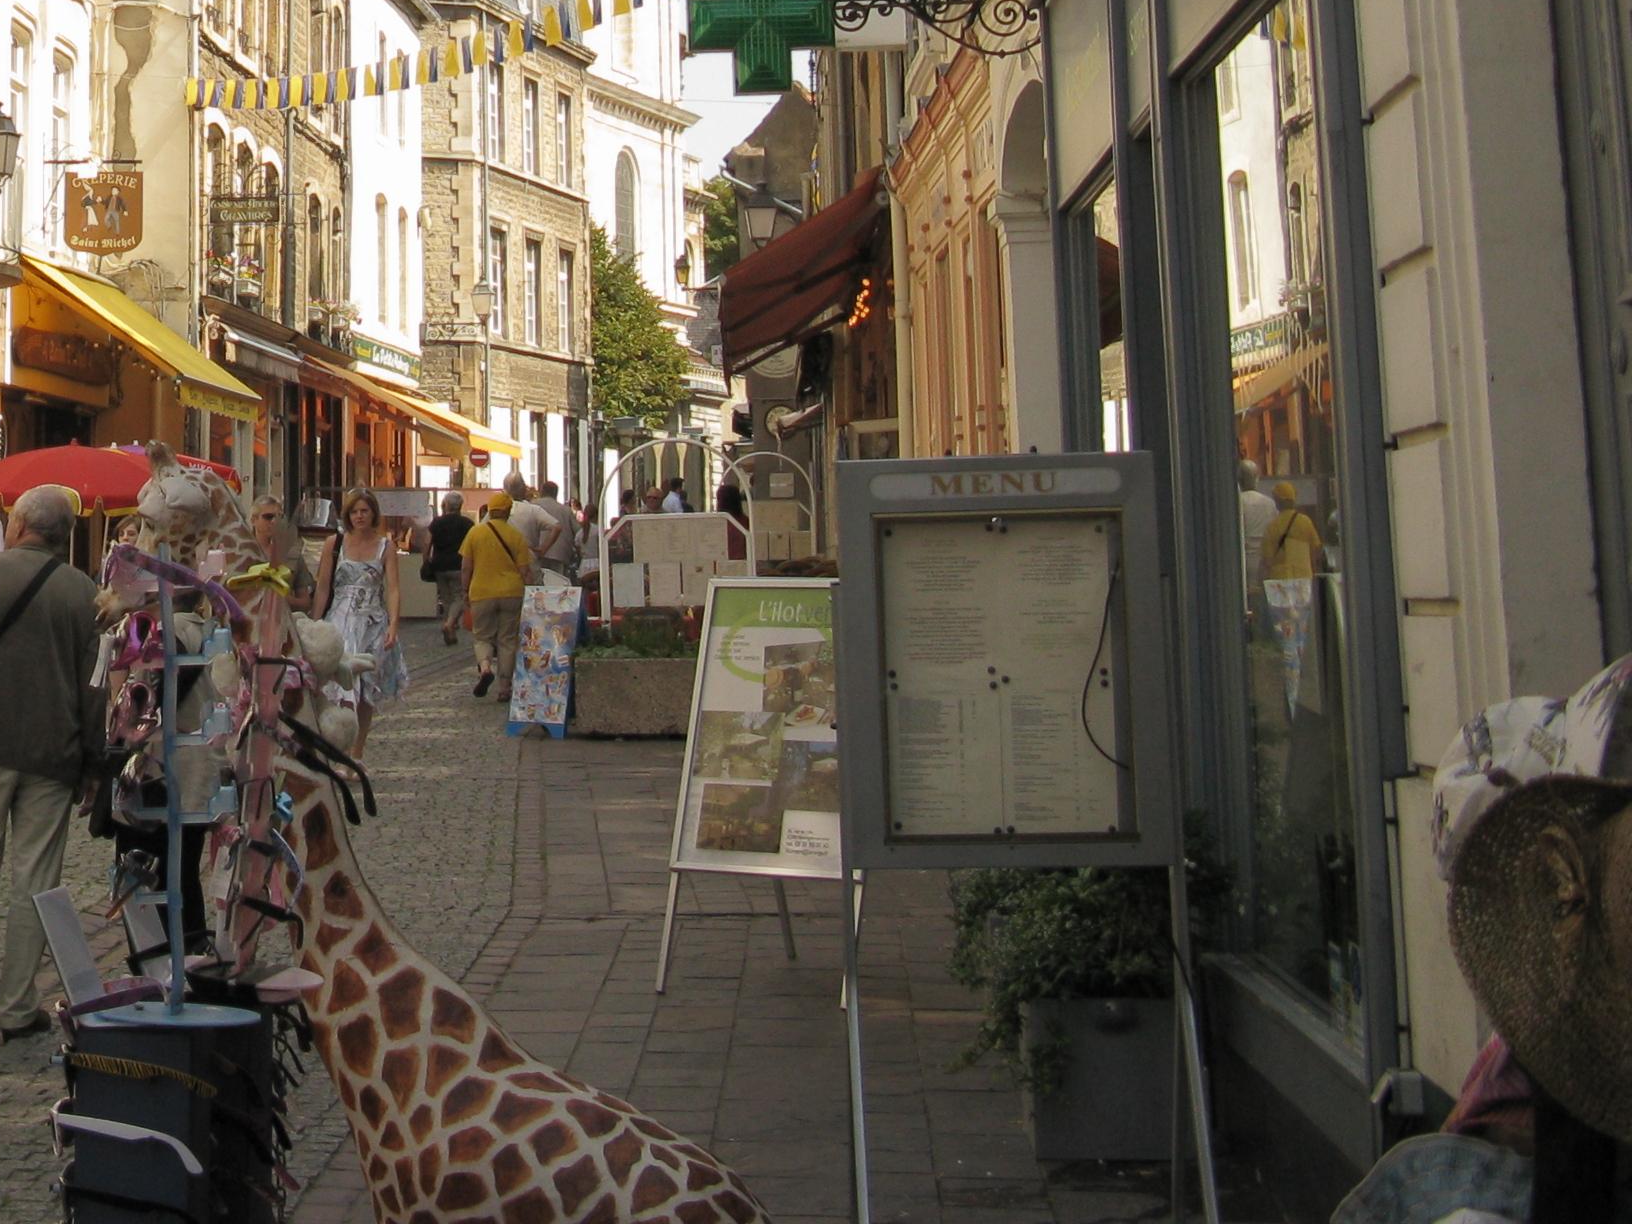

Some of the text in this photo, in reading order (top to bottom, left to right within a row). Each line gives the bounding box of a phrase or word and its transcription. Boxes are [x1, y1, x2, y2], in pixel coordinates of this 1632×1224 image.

[70, 235, 136, 249] Saint Michel
[929, 471, 1057, 495] MENU
